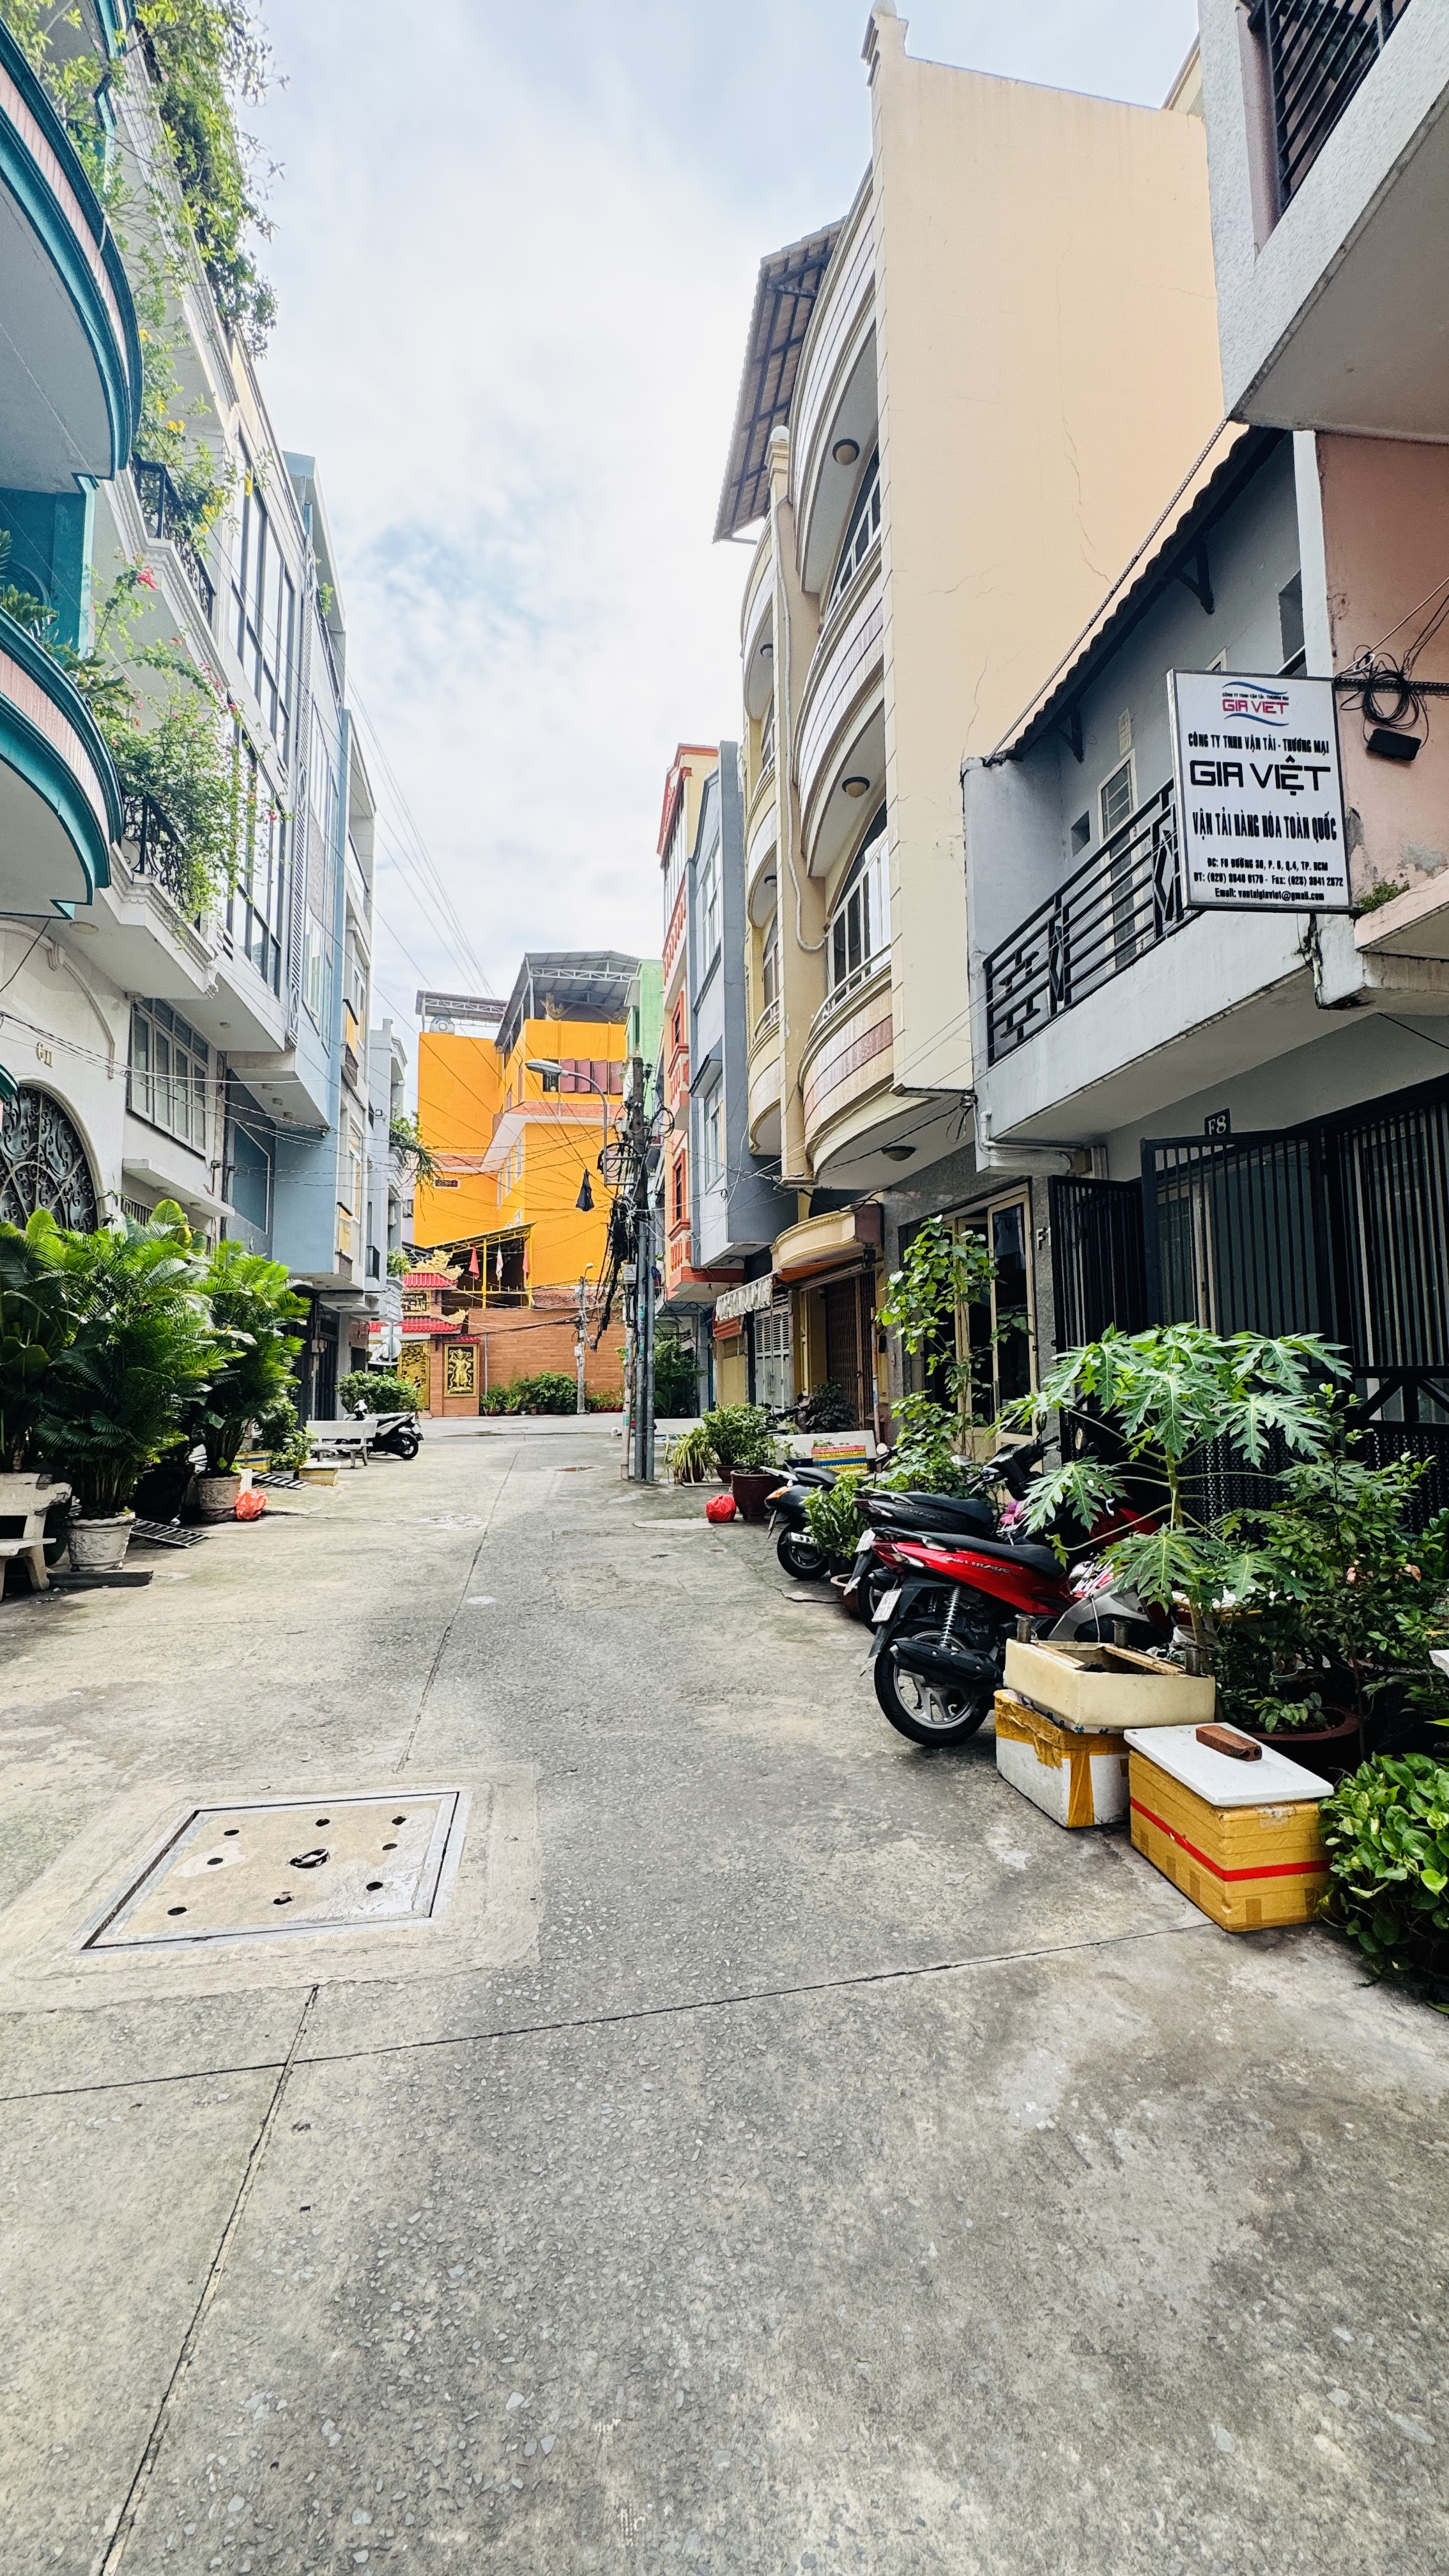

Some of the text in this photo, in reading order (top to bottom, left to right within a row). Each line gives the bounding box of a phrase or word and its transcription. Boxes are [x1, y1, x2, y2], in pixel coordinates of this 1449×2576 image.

[1222, 699, 1248, 712] GIA
[1188, 731, 1209, 747] CÔNG
[1211, 734, 1220, 748] TY
[1223, 735, 1243, 749] TNHH
[1245, 734, 1261, 753] VẬN
[1263, 734, 1276, 751] TẢI
[1282, 737, 1312, 753] THƯƠNG
[1314, 740, 1330, 756] MẠI
[1190, 755, 1331, 796] GIA VIỆT
[1192, 806, 1337, 843] VẬN TẢI HÀNG HÓA TOÀN QUỐC
[1301, 861, 1312, 871] TP.
[1271, 875, 1285, 885] Fax:
[1215, 887, 1236, 898] Email:
